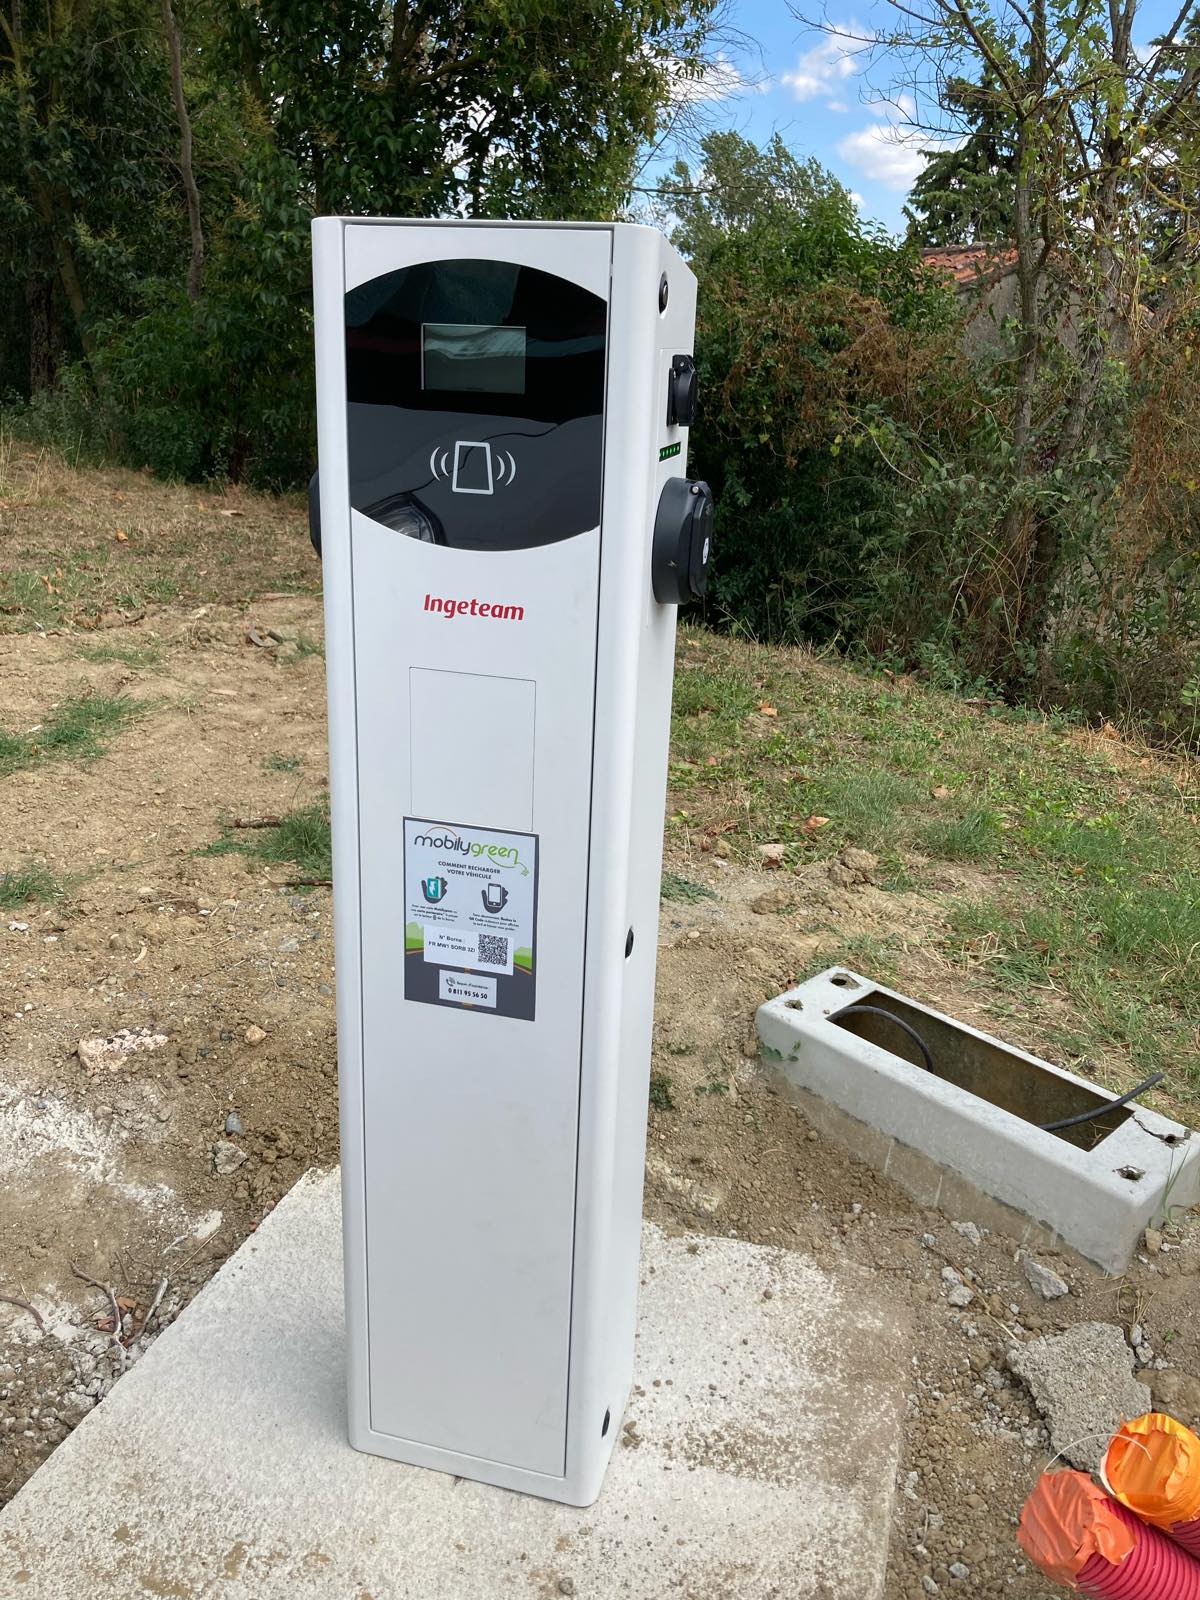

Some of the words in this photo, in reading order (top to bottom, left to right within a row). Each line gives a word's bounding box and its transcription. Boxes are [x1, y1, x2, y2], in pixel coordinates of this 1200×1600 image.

[423, 594, 524, 621] Ingeteam
[414, 835, 519, 865] mobilygreen
[438, 860, 467, 870] COMMENT
[467, 865, 501, 874] RECHARGER
